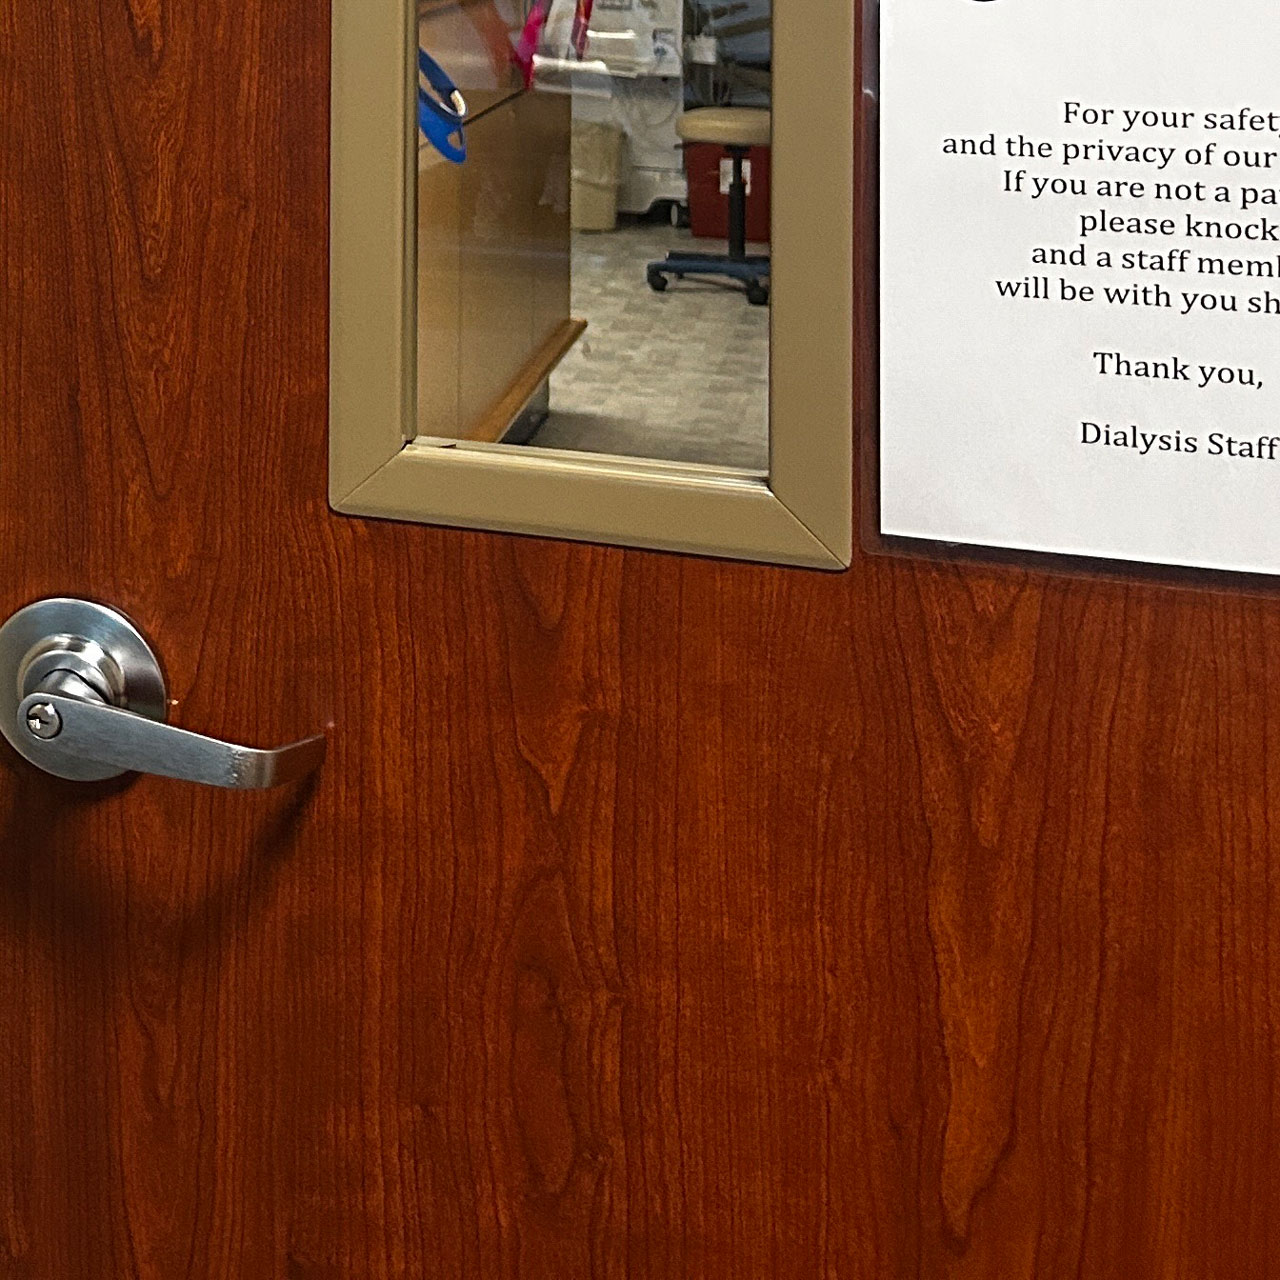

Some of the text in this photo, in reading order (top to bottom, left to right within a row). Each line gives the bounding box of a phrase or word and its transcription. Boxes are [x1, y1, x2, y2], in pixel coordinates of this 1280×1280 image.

[1064, 101, 1280, 138] For your safet
[942, 133, 1278, 170] and the privacy of our
[1004, 169, 1280, 210] If you are not a pa
[1079, 209, 1280, 242] please knock
[1032, 243, 1280, 278] and a staff mem
[995, 276, 1280, 315] will be with you sh
[1093, 351, 1263, 390] Thank you,
[1081, 421, 1280, 460] Dialysis Staff
